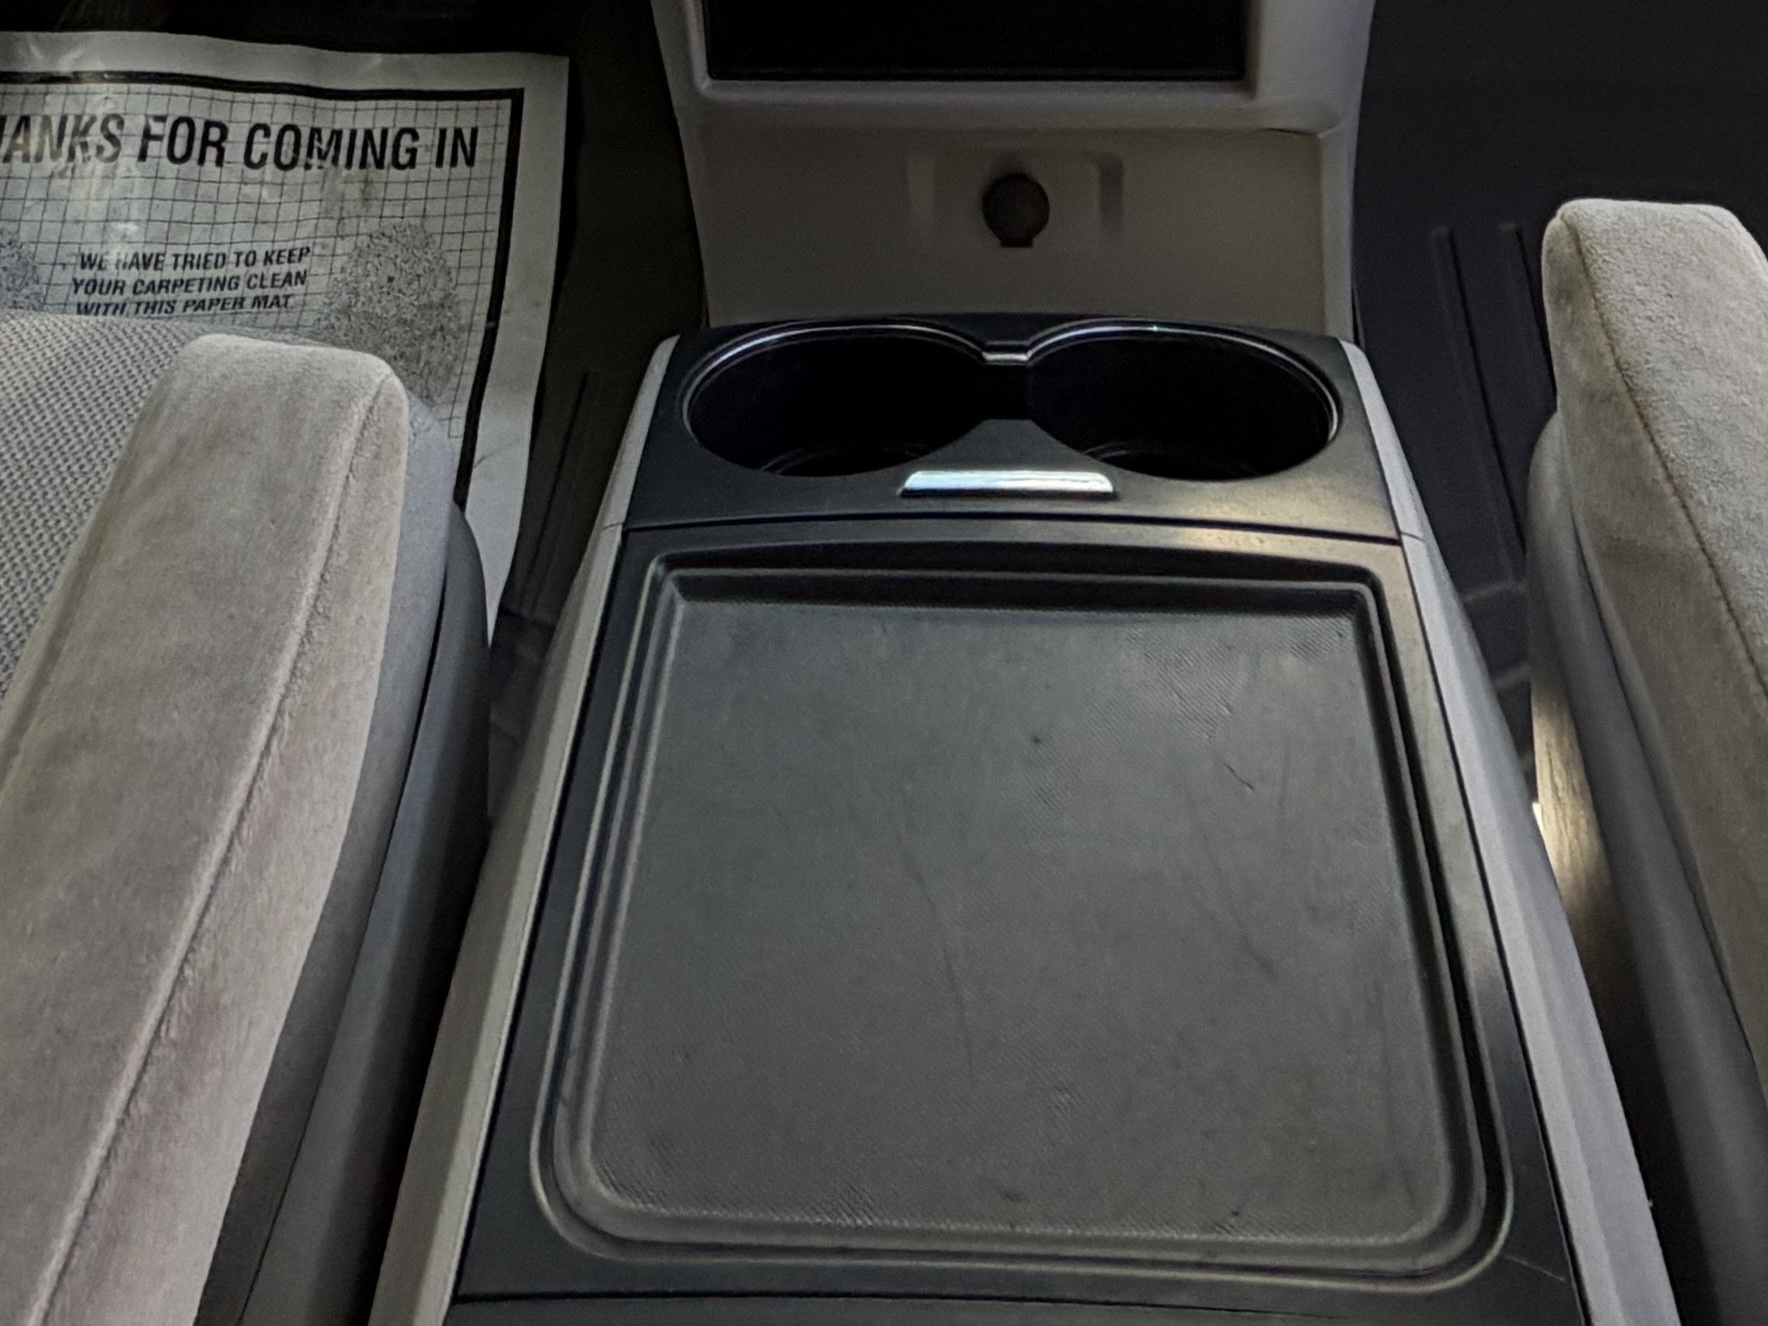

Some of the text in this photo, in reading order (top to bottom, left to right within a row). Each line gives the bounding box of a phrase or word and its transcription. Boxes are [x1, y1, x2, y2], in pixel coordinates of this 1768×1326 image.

[138, 114, 230, 168] FOR
[242, 122, 420, 172] COMING
[434, 125, 479, 170] IN
[79, 245, 312, 272] WE HAVE TRIED TO KEEP
[72, 268, 308, 298] YOUR CARPETING CLEAN
[75, 300, 127, 316] WITH
[131, 297, 177, 315] THIS
[181, 296, 246, 313] PAPER
